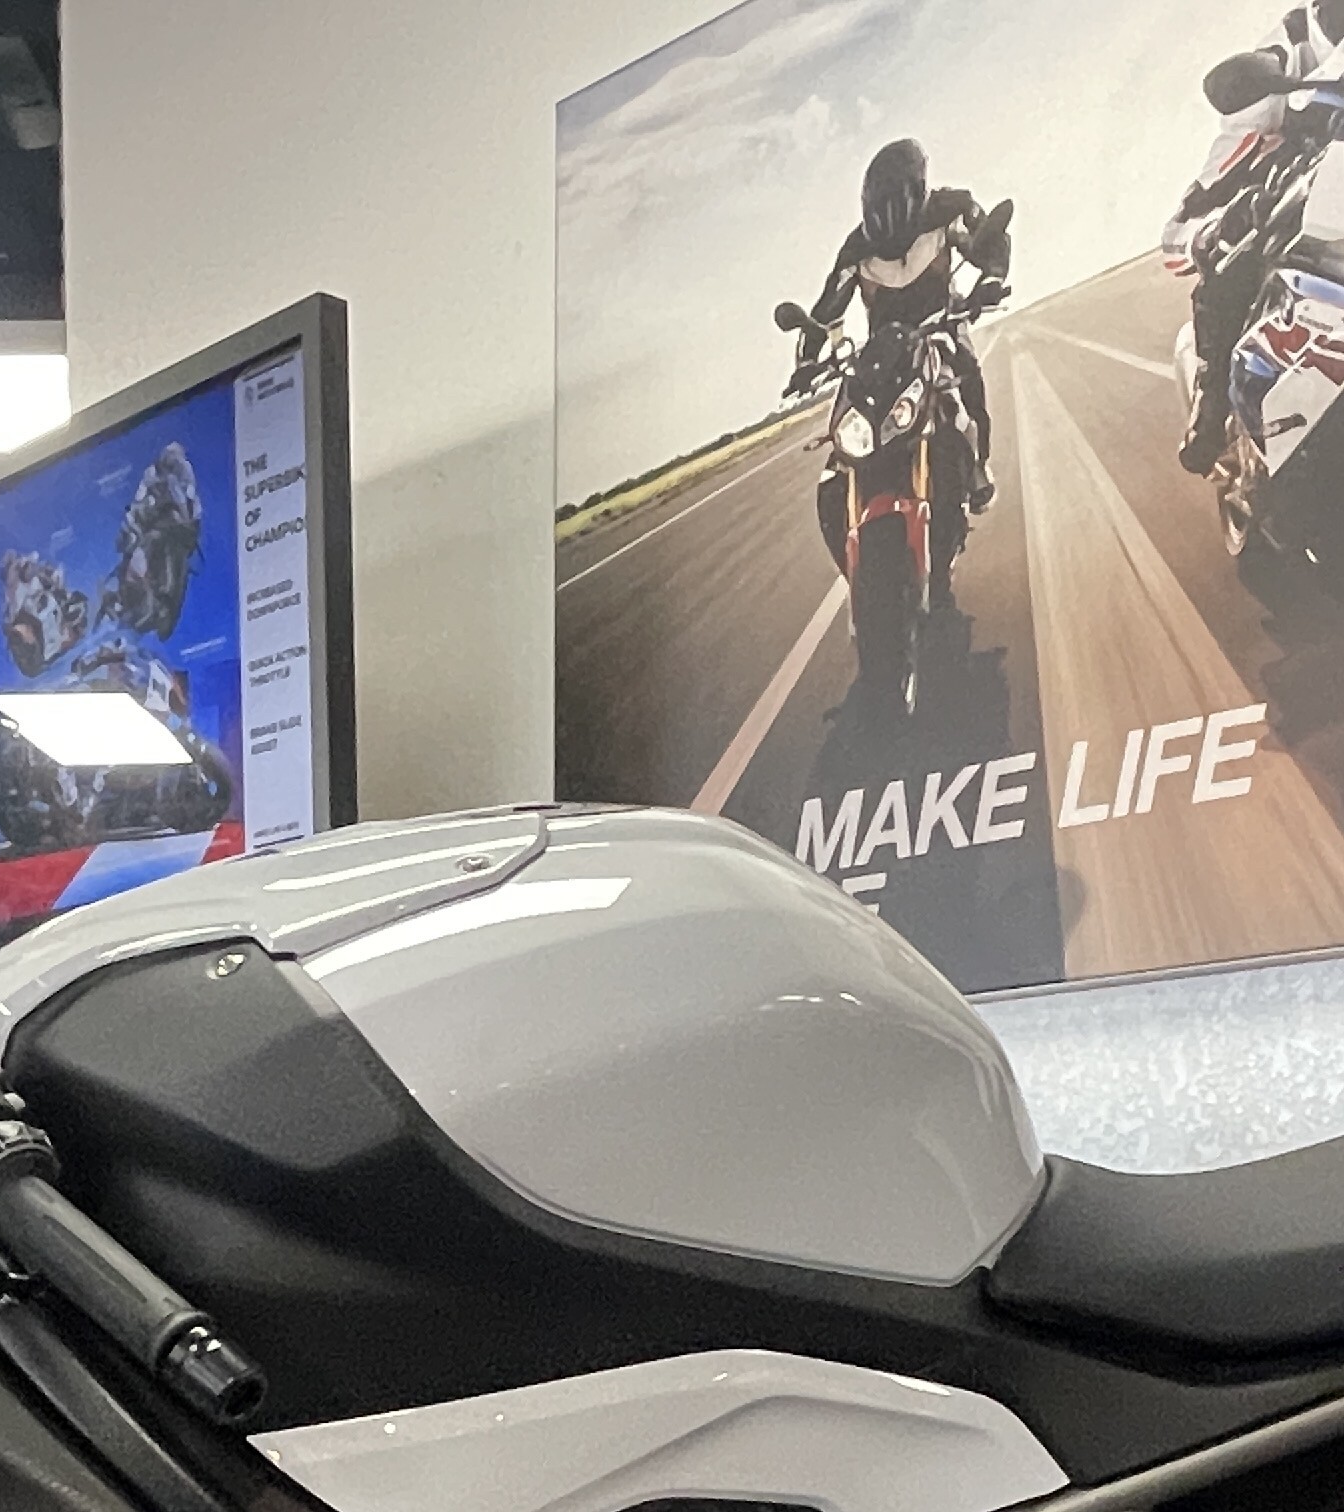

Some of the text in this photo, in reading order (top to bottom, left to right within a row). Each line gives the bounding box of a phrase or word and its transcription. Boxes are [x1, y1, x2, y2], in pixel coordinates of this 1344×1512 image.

[243, 452, 268, 477] THE
[244, 507, 262, 527] OF
[795, 703, 1267, 873] MAKE LIFE
